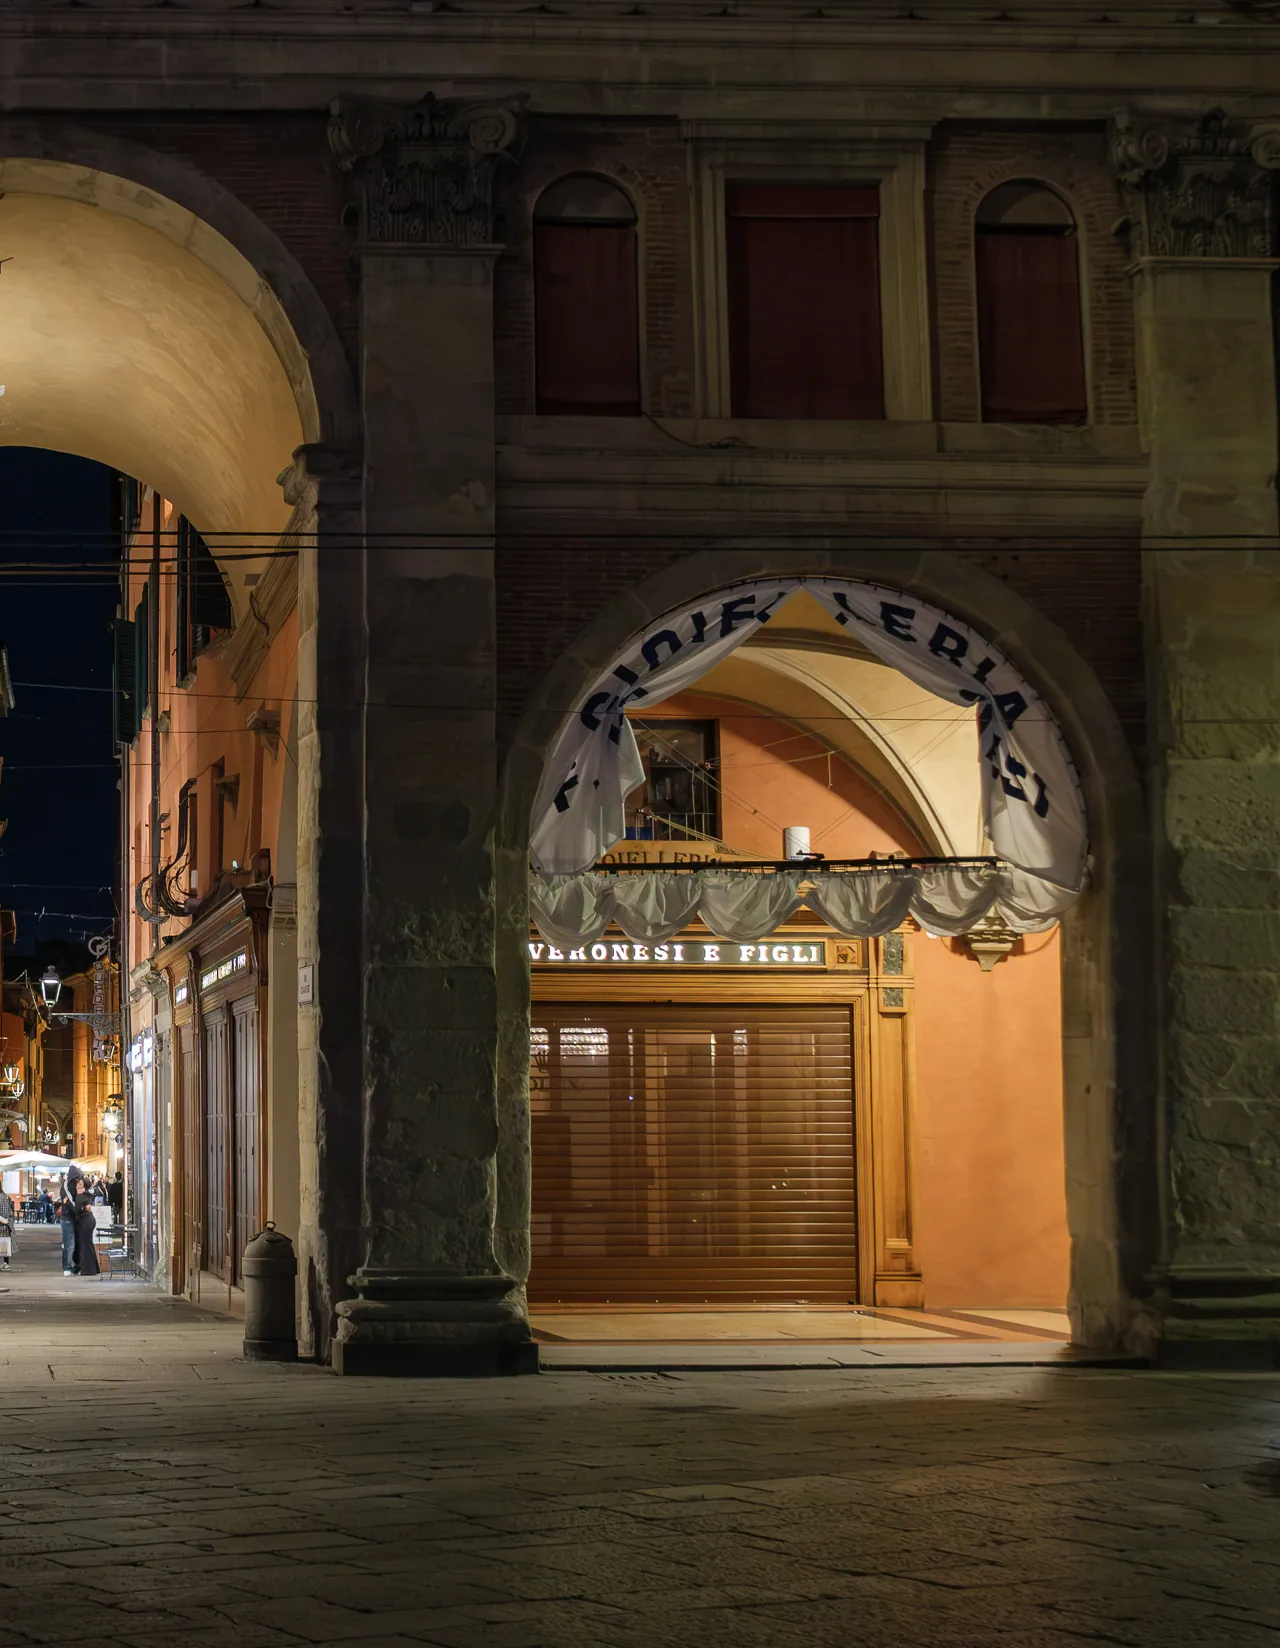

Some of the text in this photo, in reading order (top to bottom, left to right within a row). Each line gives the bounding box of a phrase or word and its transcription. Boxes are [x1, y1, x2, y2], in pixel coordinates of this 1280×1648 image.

[528, 942, 819, 963] VERONESI E FIGLI
